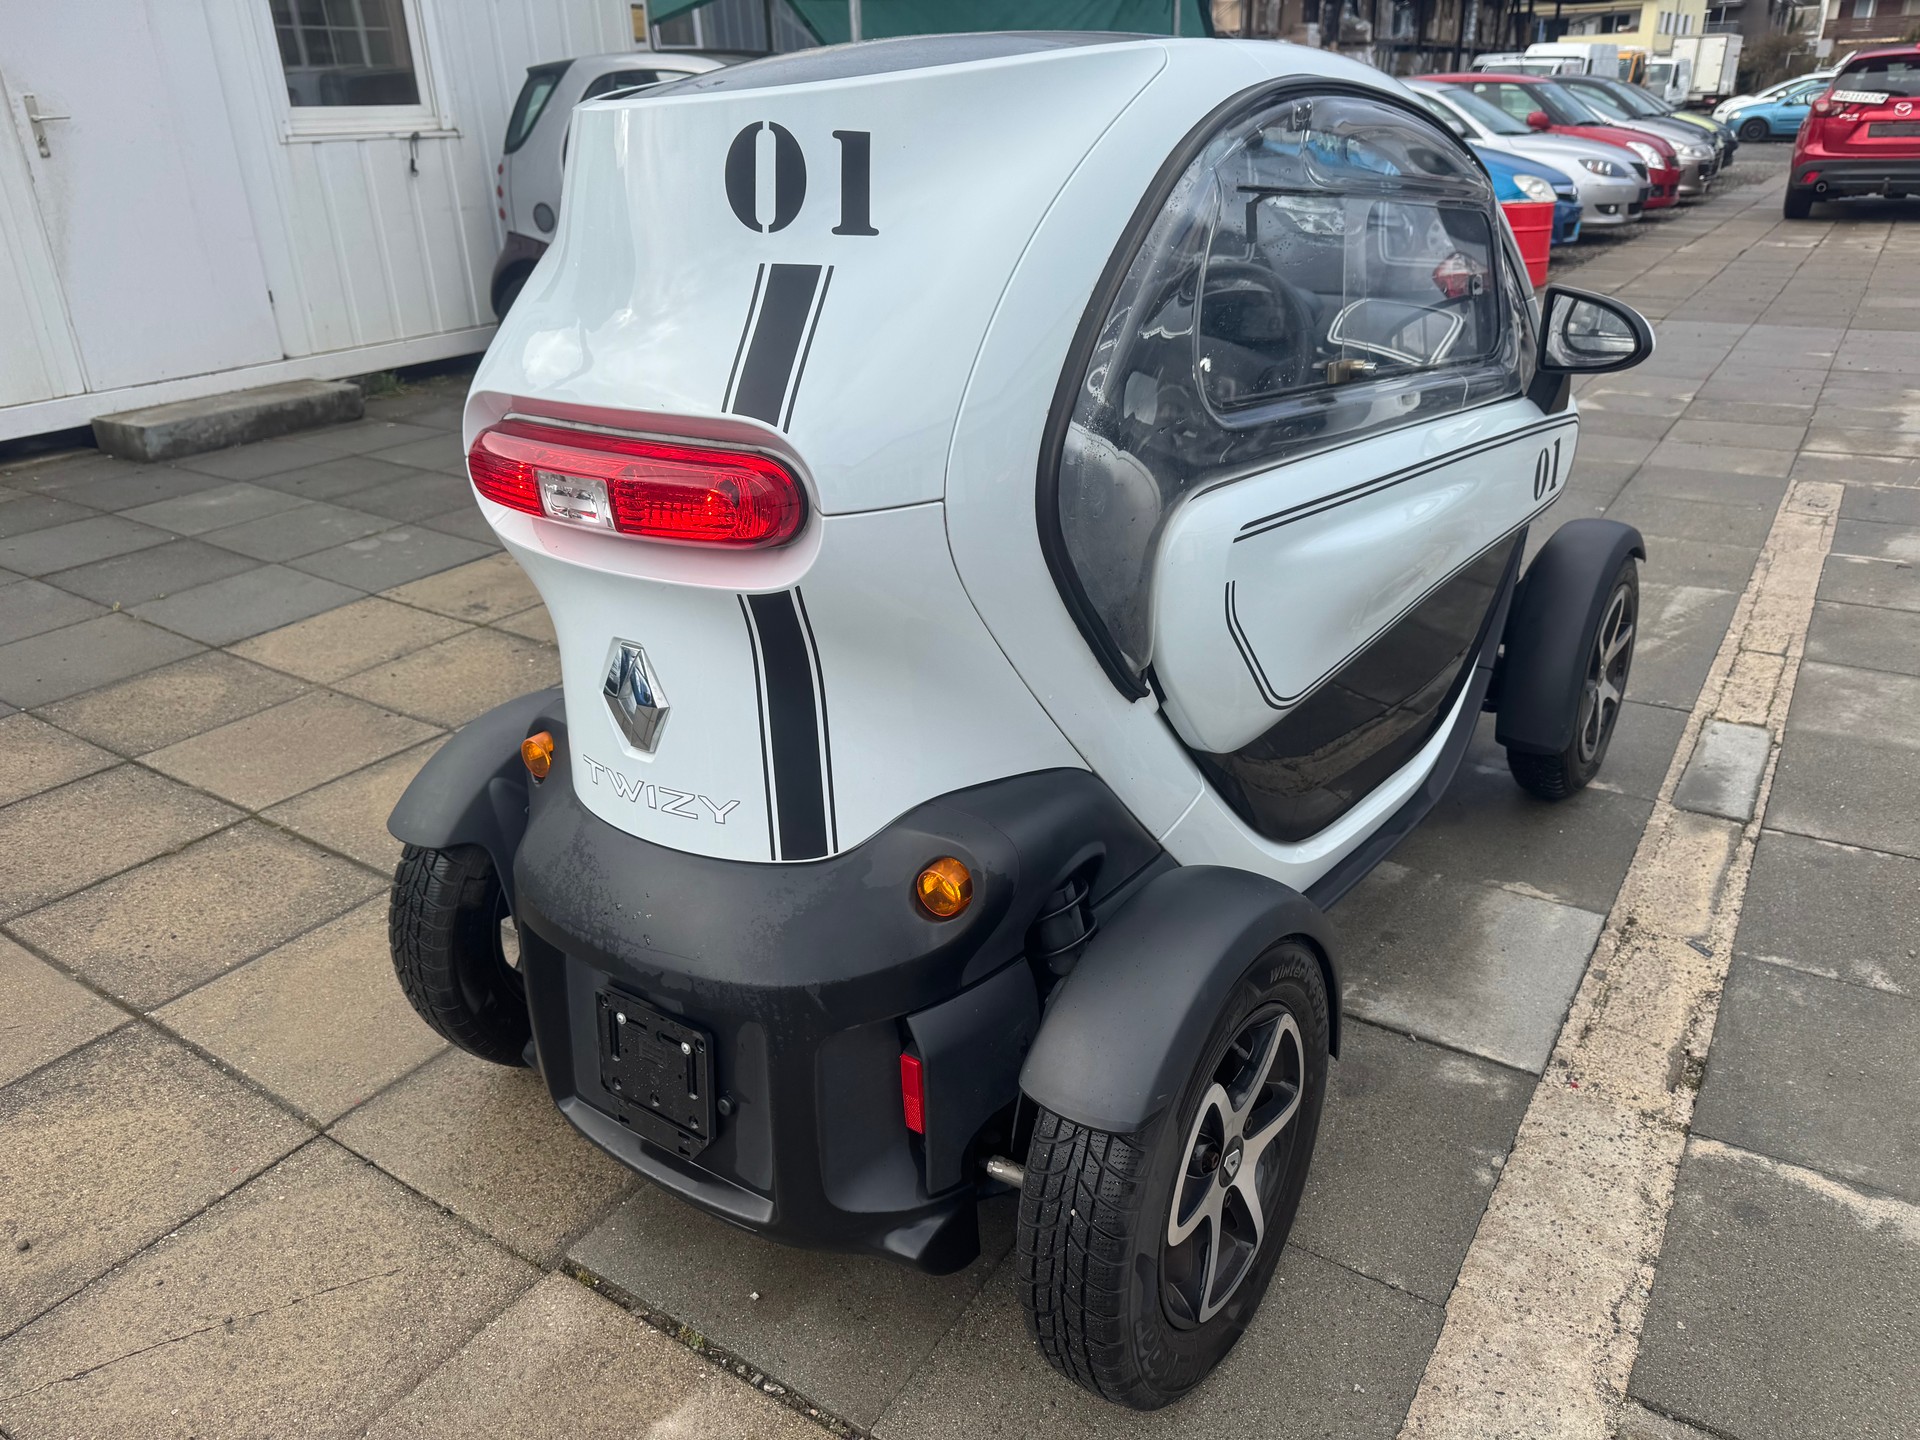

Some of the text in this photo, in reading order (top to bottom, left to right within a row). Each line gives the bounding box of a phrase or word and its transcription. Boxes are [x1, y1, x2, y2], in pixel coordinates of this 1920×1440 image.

[725, 121, 879, 236] 01
[1534, 437, 1561, 501] 01
[583, 754, 741, 824] TWIZY
